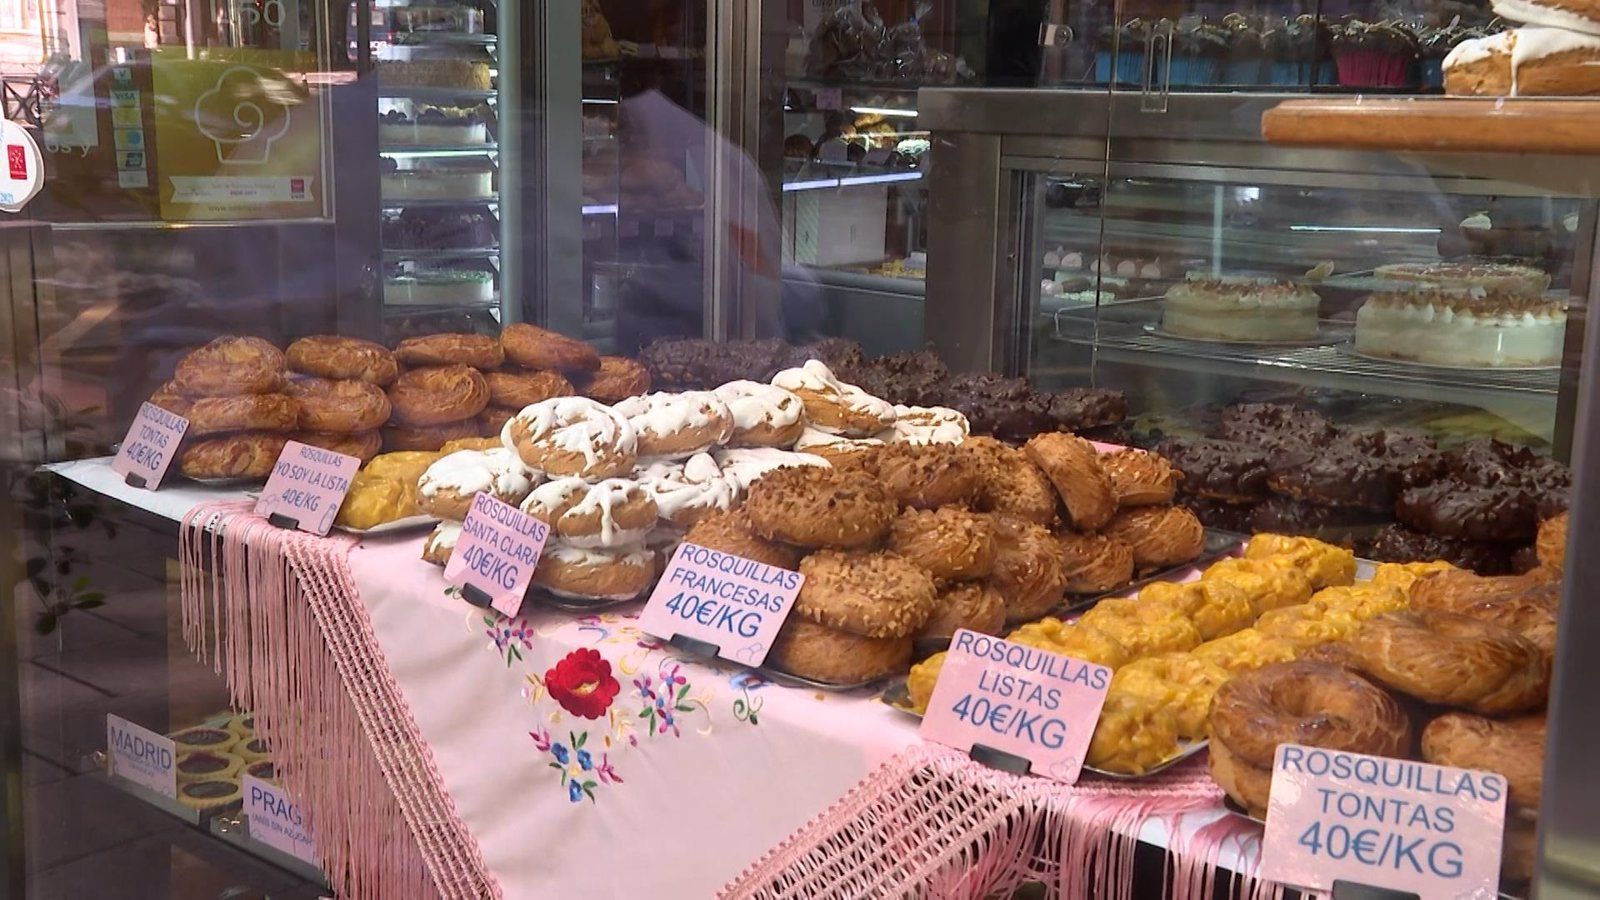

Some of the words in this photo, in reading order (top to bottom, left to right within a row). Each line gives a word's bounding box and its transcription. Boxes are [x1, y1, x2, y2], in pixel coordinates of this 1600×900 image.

[140, 424, 170, 449] TONTAS
[142, 403, 187, 434] ROSQUILLAS
[127, 441, 163, 471] 40€/KG
[276, 461, 291, 477] YO
[289, 465, 310, 481] SOY
[308, 470, 321, 486] LA
[320, 475, 348, 493] LISTA
[300, 446, 344, 467] ROSQUILLAS
[282, 488, 322, 512] 40€/KG
[474, 494, 546, 542] ROSQUILLAS
[463, 516, 499, 548] SANTA
[500, 535, 538, 567] CLARA
[463, 544, 519, 590] 40€/KG
[679, 544, 800, 591] ROSQUILLAS
[669, 567, 784, 613] FRANCESAS
[665, 591, 762, 638] 40€/KG
[955, 632, 1108, 690] ROSQUILLAS
[978, 669, 1062, 711] LISTAS
[952, 694, 1067, 749] 40€/KG
[111, 726, 172, 770] MADRID
[1281, 747, 1501, 802] ROSQUILLAS
[251, 786, 302, 826] PRAG
[1317, 788, 1455, 833] TONTAS
[1299, 821, 1464, 879] 40€/KG
